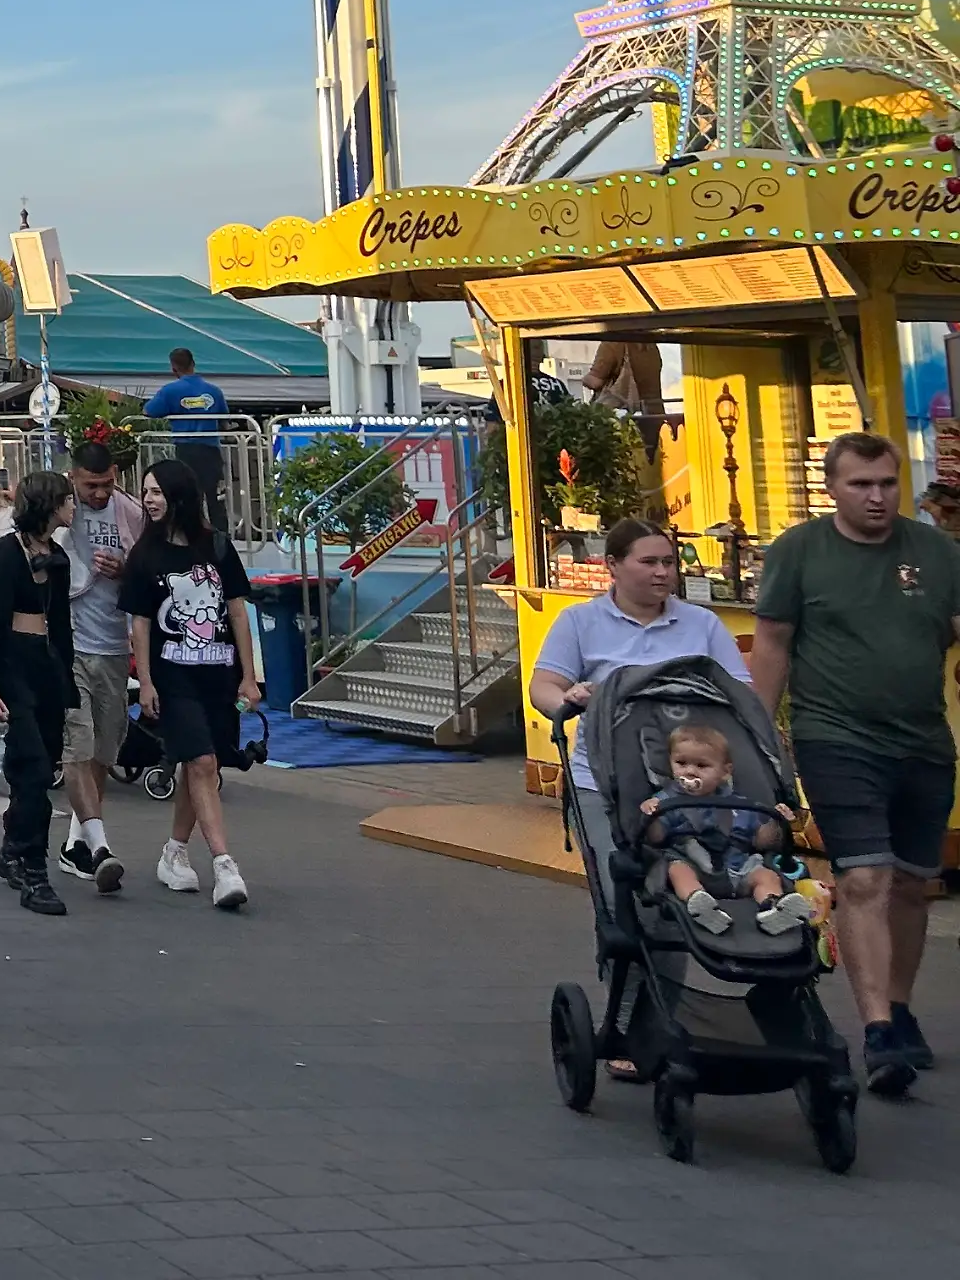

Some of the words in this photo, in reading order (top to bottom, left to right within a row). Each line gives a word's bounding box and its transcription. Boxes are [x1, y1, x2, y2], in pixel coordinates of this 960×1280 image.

[359, 207, 463, 257] Crêpes
[359, 509, 422, 565] EINGANG
[162, 641, 201, 663] Hello
